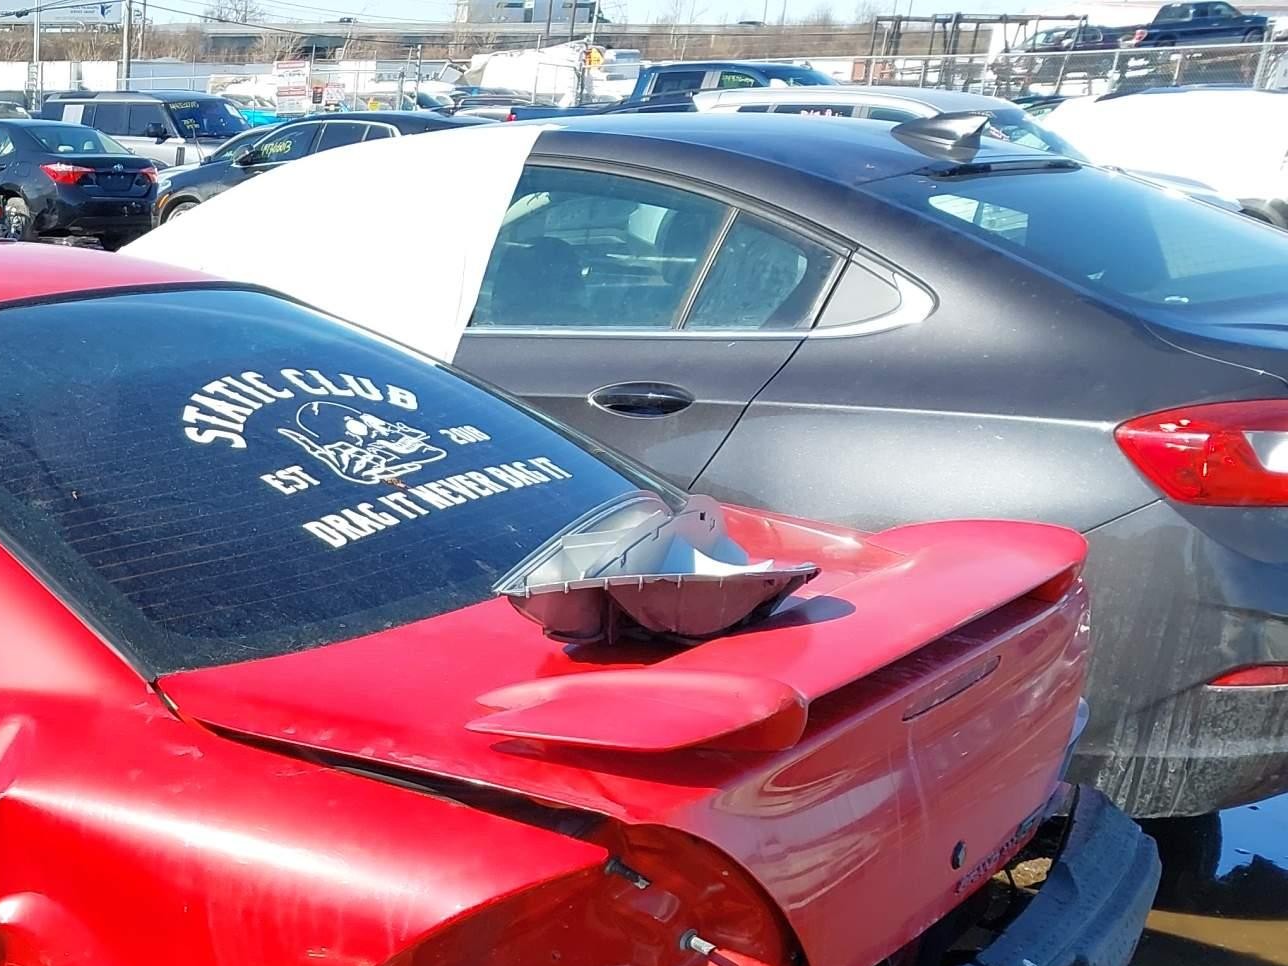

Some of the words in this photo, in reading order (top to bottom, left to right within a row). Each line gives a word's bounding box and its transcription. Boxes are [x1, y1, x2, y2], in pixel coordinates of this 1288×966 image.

[182, 371, 295, 448] STATIC
[280, 368, 418, 411] CLUB
[260, 465, 321, 495] EST
[302, 502, 401, 548] DRAG
[377, 491, 430, 519] IT
[407, 471, 509, 510] NEVER
[483, 461, 552, 488] BAG
[527, 456, 573, 479] IT
